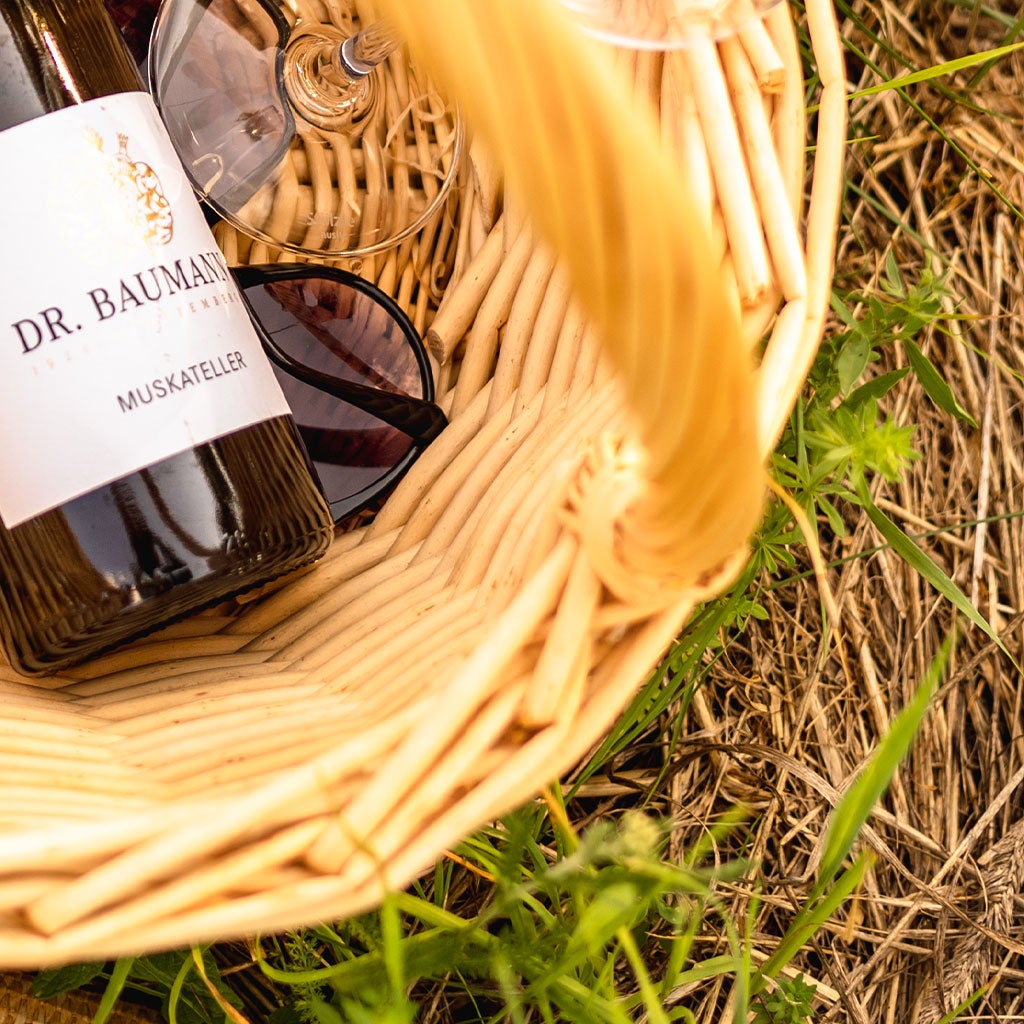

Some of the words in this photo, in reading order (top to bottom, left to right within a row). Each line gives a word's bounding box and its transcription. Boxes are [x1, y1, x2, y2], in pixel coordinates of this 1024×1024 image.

[10, 306, 83, 354] DR.
[86, 251, 230, 322] BAUMANN
[116, 350, 248, 414] MUSKATELLER
